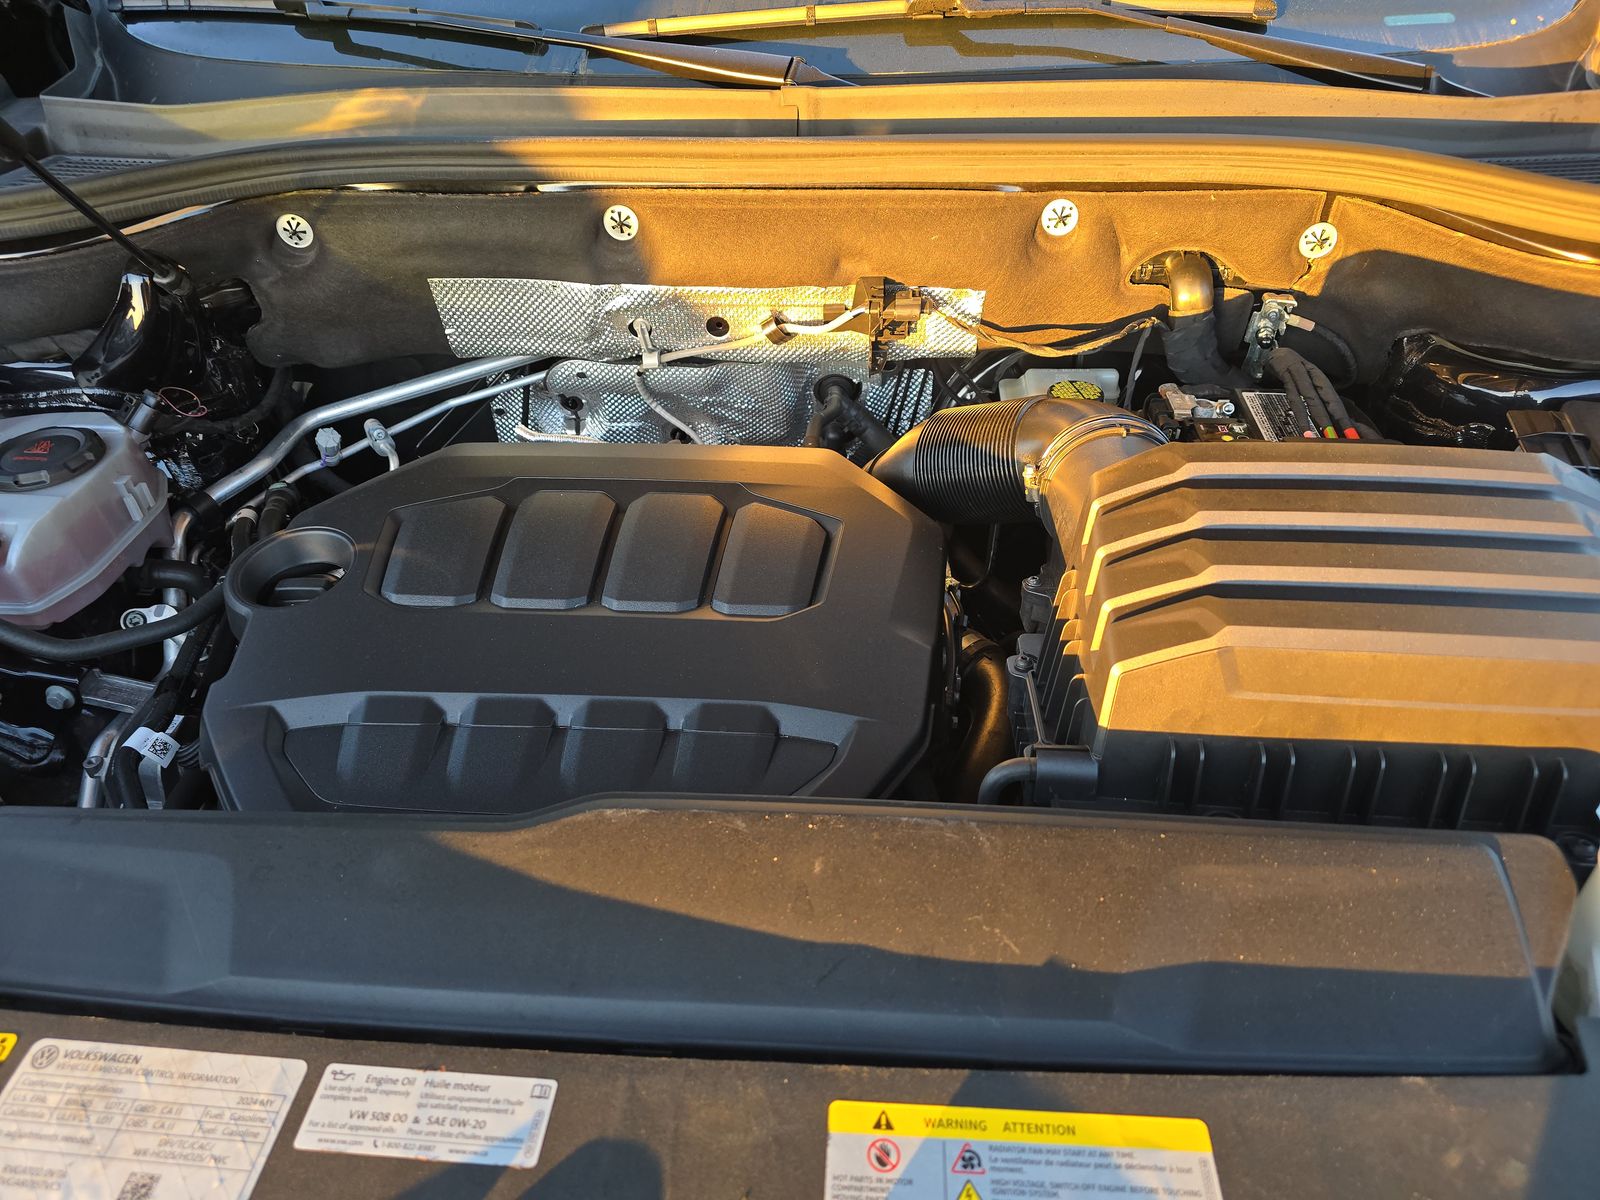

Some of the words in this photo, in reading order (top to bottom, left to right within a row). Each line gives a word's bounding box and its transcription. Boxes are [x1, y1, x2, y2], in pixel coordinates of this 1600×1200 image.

[64, 1049, 142, 1064] VOLKSWAGEN
[56, 1063, 91, 1072] VEHICLE
[91, 1064, 134, 1075] EMISSION
[135, 1067, 174, 1080] CONTROL
[177, 1071, 240, 1084] INFORMATION
[365, 1074, 400, 1086] Engine
[401, 1076, 417, 1086] Oil
[424, 1078, 452, 1090] Huile
[452, 1082, 491, 1092] moteur
[230, 1112, 268, 1123] Gasoline
[349, 1109, 369, 1120] VW
[370, 1111, 391, 1121] 508
[392, 1112, 408, 1123] 00
[412, 1116, 421, 1124] &
[426, 1115, 448, 1126] SAE
[449, 1117, 488, 1130] 0W-20
[222, 1127, 260, 1138] Gasoline
[924, 1116, 988, 1132] WARNING
[1002, 1121, 1076, 1136] ATTENTION
